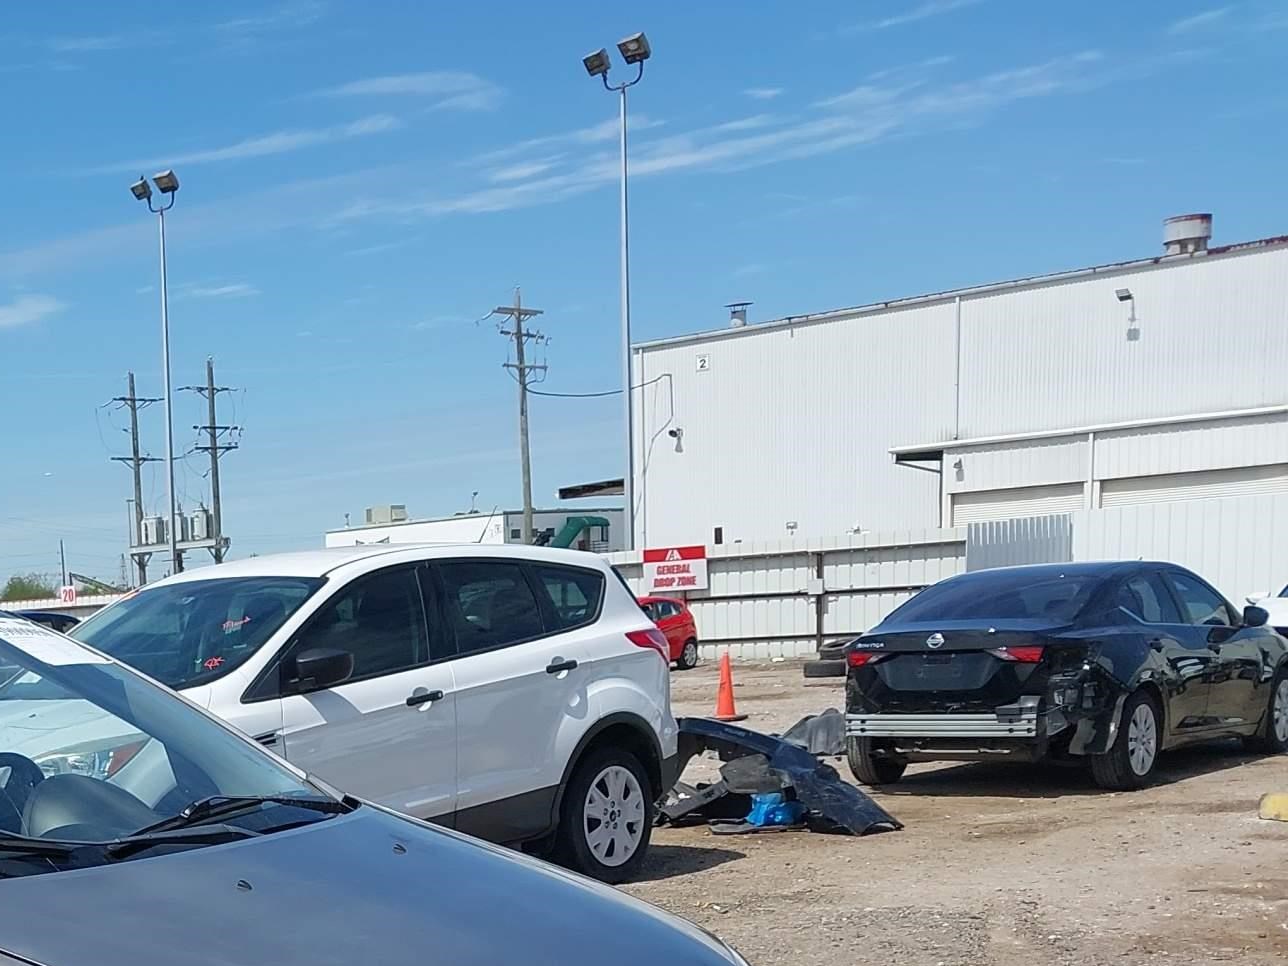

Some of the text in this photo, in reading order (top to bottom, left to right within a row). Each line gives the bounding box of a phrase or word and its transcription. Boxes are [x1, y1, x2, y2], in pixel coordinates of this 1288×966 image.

[699, 358, 707, 369] 2
[656, 563, 691, 576] GENERAL
[653, 575, 697, 588] DROP ZONE
[62, 588, 74, 603] 20
